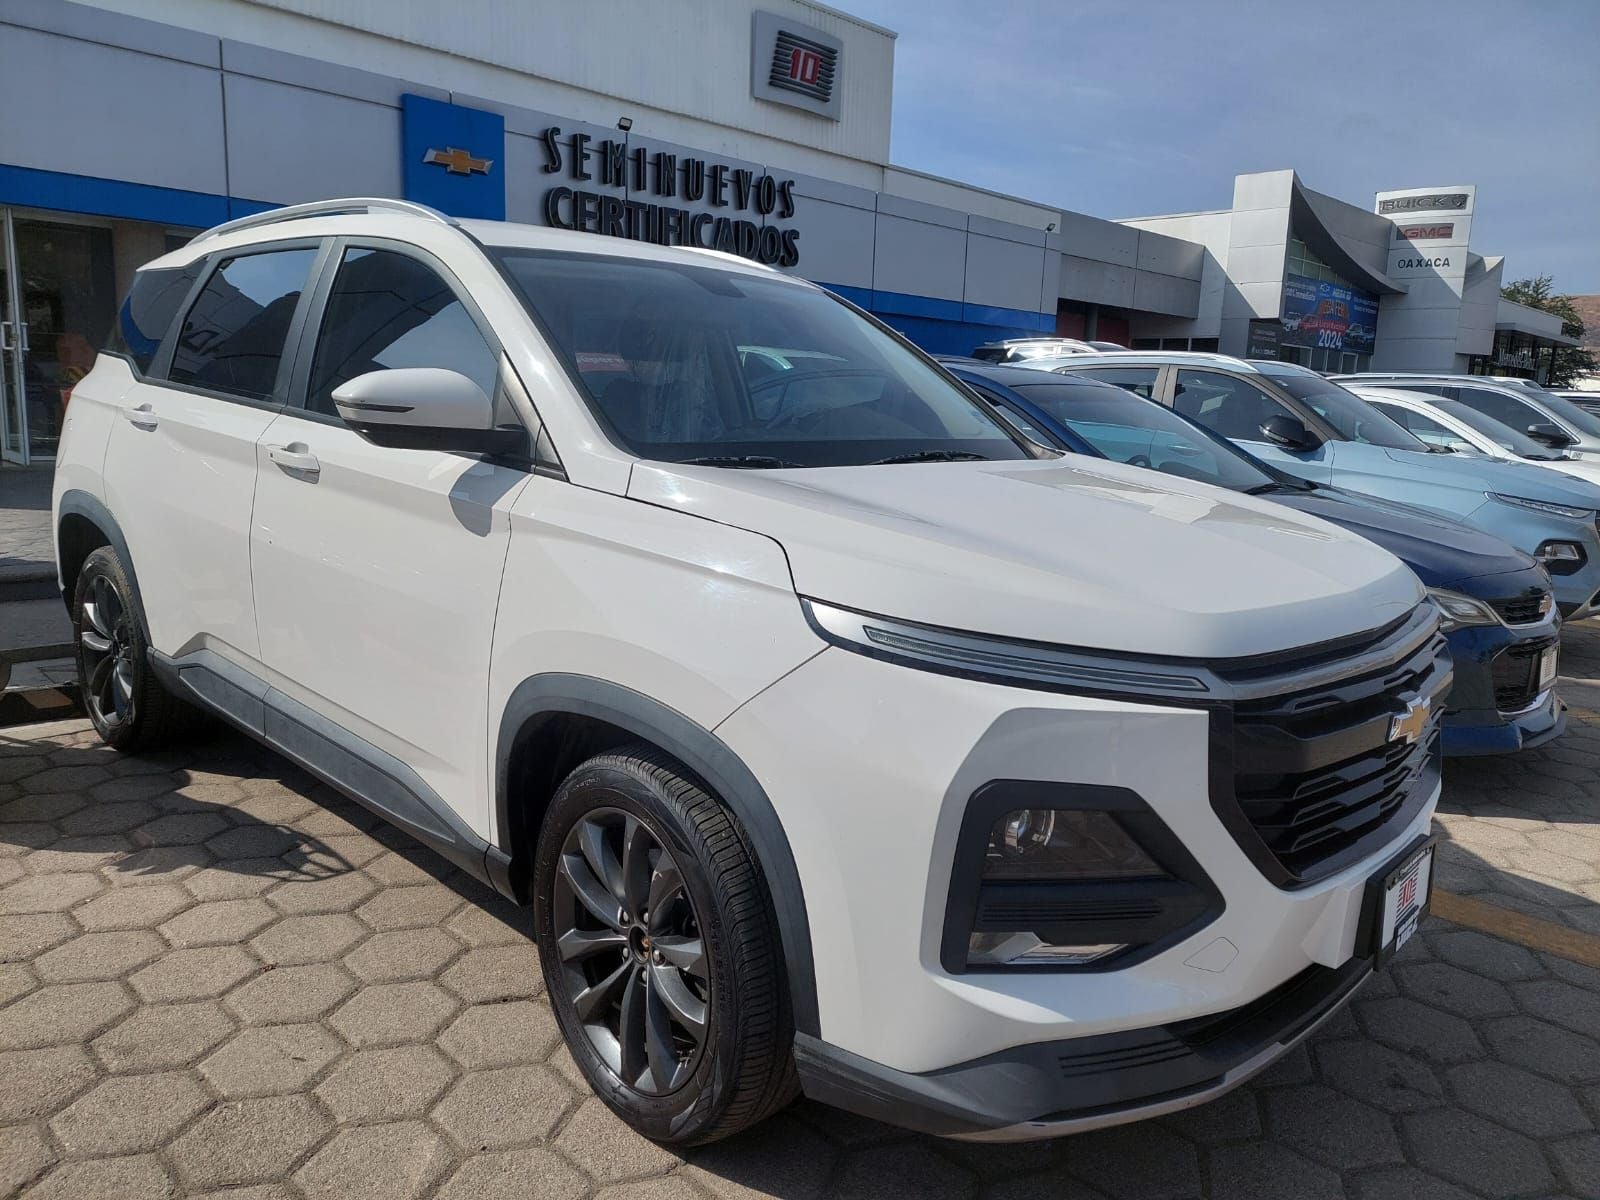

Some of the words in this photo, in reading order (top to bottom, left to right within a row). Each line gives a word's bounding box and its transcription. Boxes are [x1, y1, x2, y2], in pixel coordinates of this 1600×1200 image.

[790, 48, 821, 84] 10
[543, 126, 796, 219] SEMINUEVOS
[1382, 196, 1447, 212] BUICK
[544, 186, 801, 267] CERTIFICADOS
[1404, 225, 1453, 240] GMC
[1397, 257, 1451, 269] OAXACA
[1318, 328, 1343, 349] 2024
